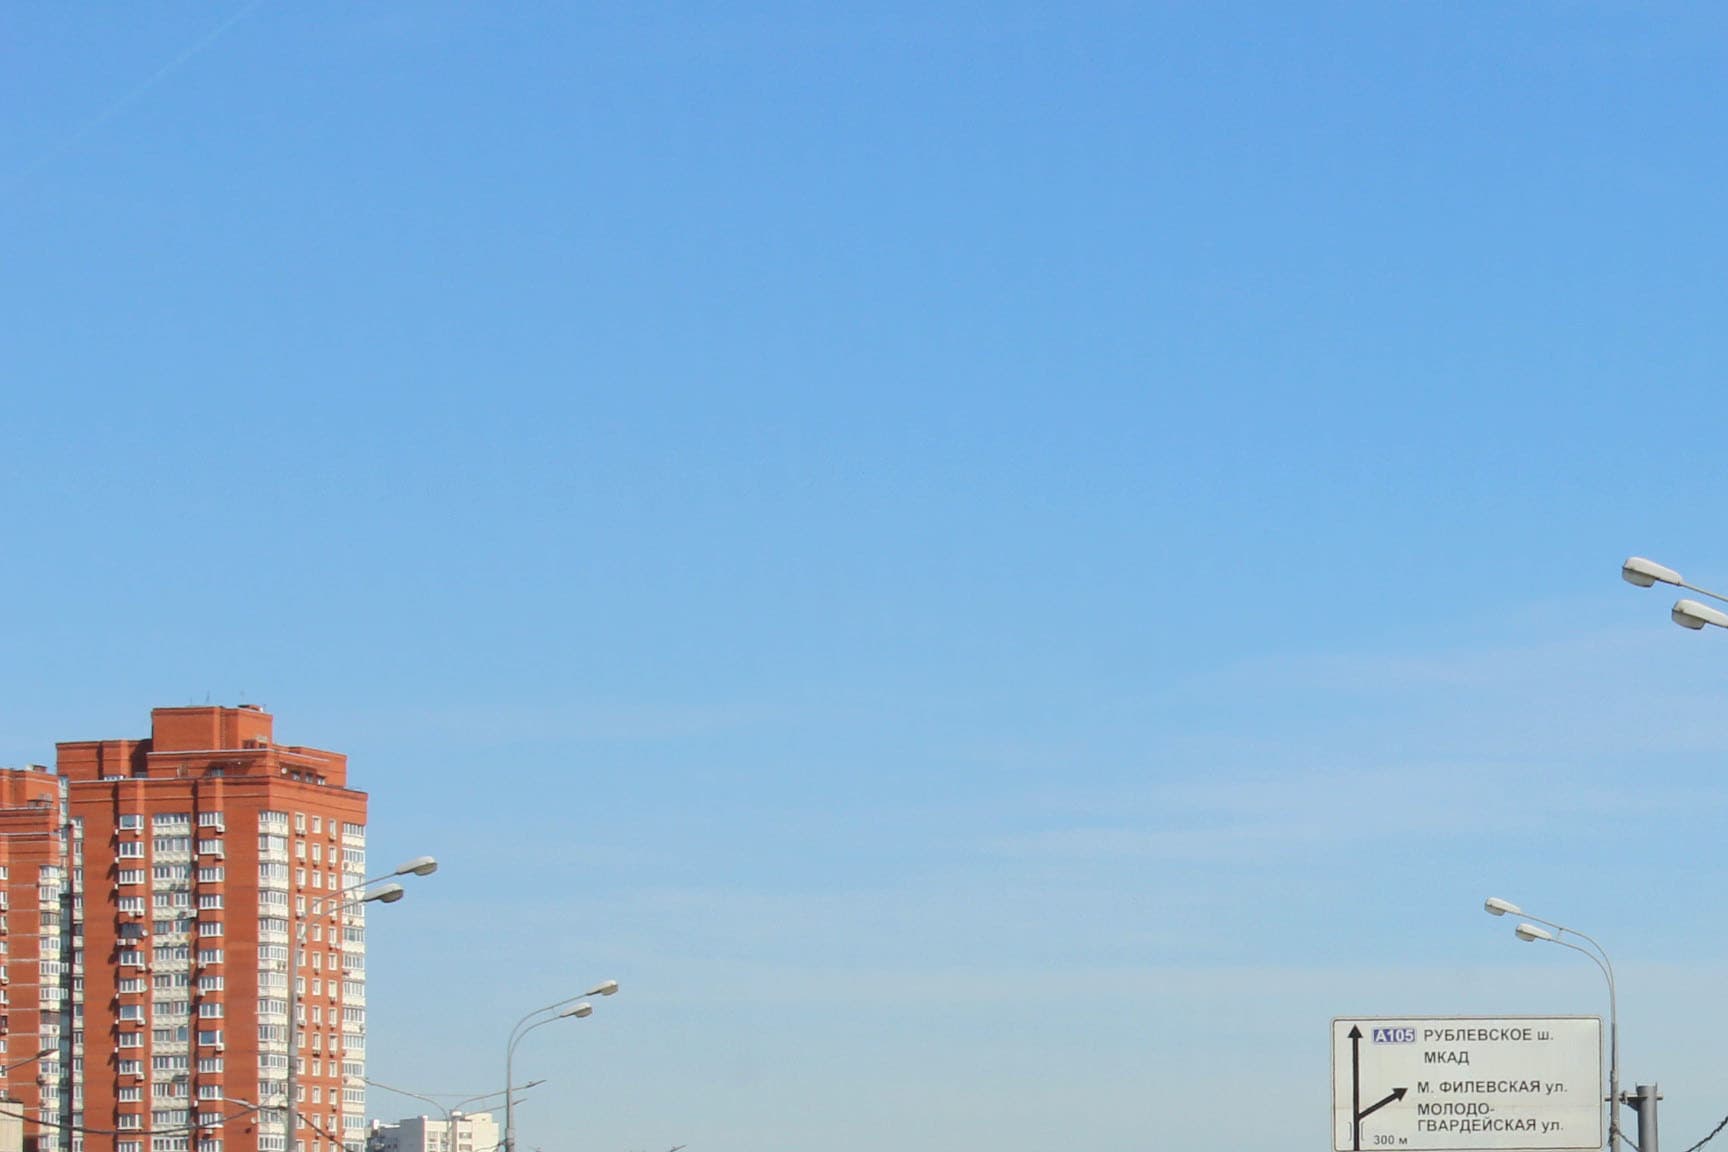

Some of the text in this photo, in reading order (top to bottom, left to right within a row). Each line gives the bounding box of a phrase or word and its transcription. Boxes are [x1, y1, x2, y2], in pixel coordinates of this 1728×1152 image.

[1423, 1028, 1532, 1042] РУБЛЕВСКОЕ
[1537, 1030, 1554, 1041] ш.
[1423, 1051, 1470, 1065] МКАД
[1417, 1080, 1568, 1096] М. ФИЛЕВСКАЯ ул.
[1417, 1102, 1495, 1117] МОЛОДО-
[1417, 1116, 1564, 1133] ГВАРДЕЙСКАЯ ул.
[1373, 1135, 1408, 1145] 300 м
